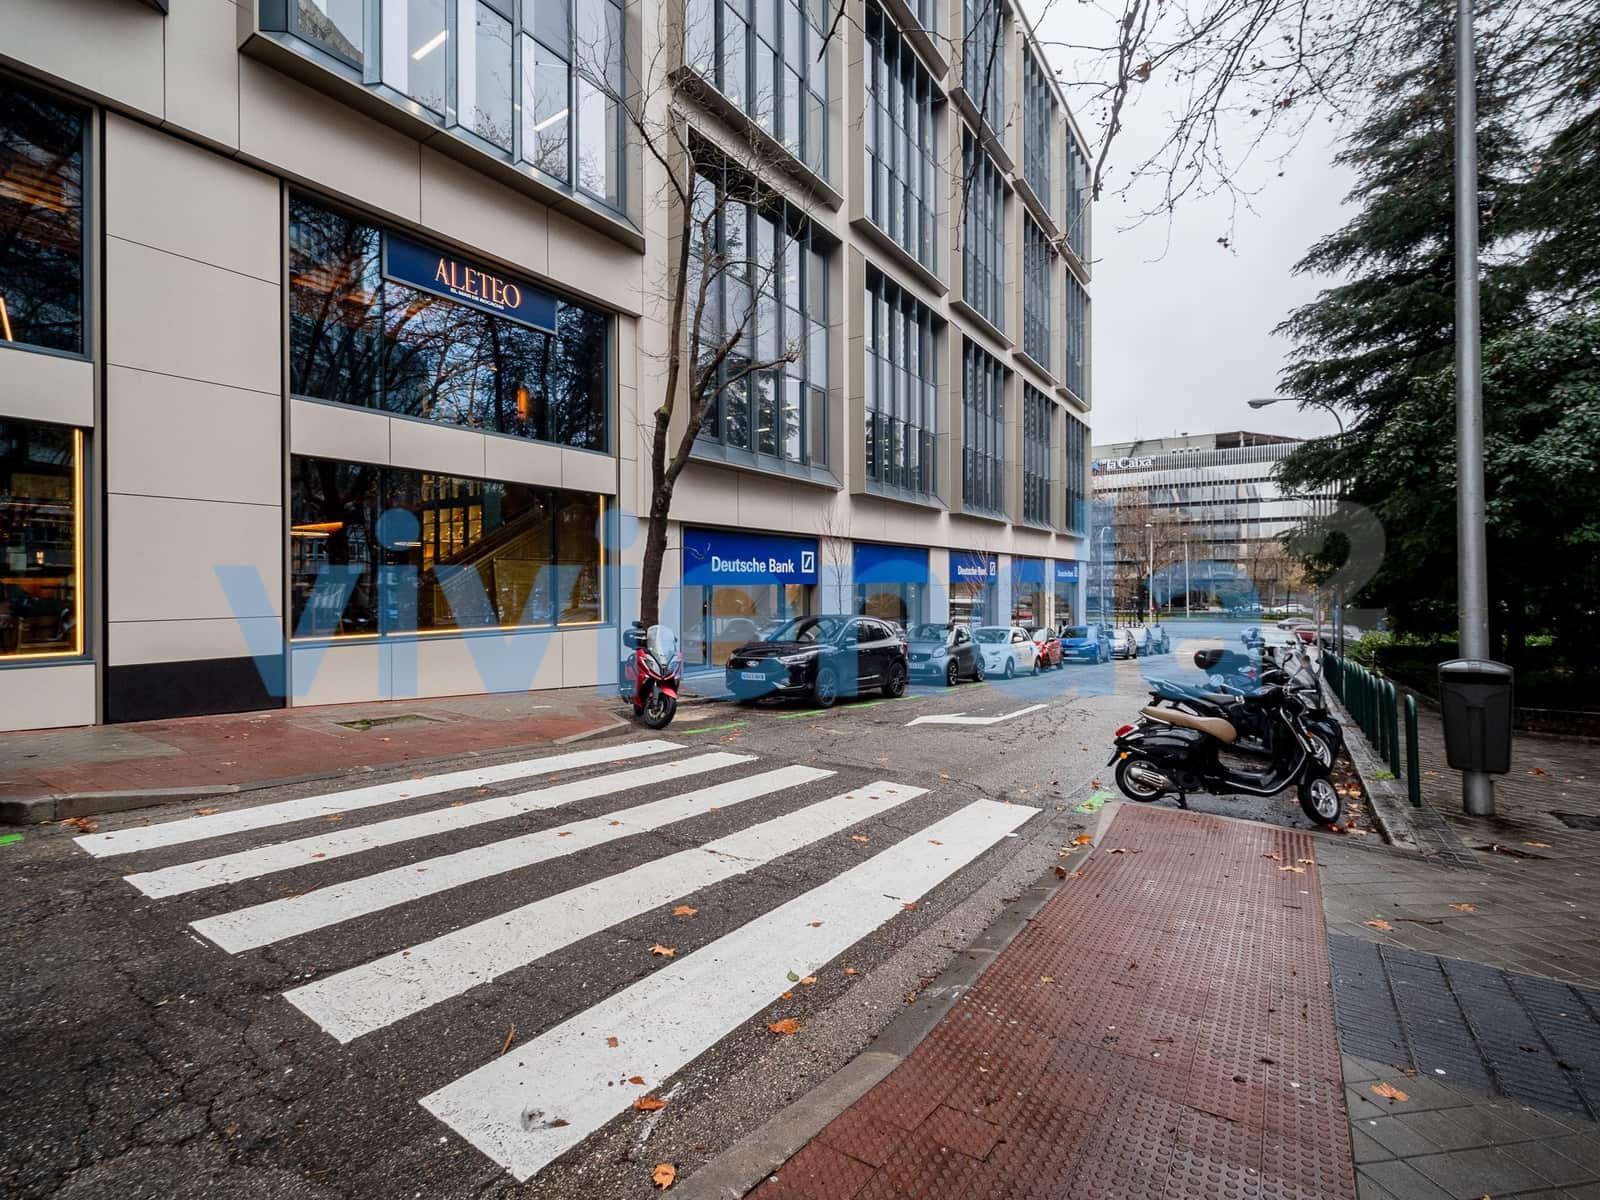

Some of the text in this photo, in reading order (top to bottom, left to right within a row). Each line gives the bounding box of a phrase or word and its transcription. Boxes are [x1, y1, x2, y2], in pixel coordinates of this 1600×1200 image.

[434, 257, 522, 309] ALETEO
[1118, 456, 1153, 469] Caixa
[711, 555, 795, 573] Deutsche Bank
